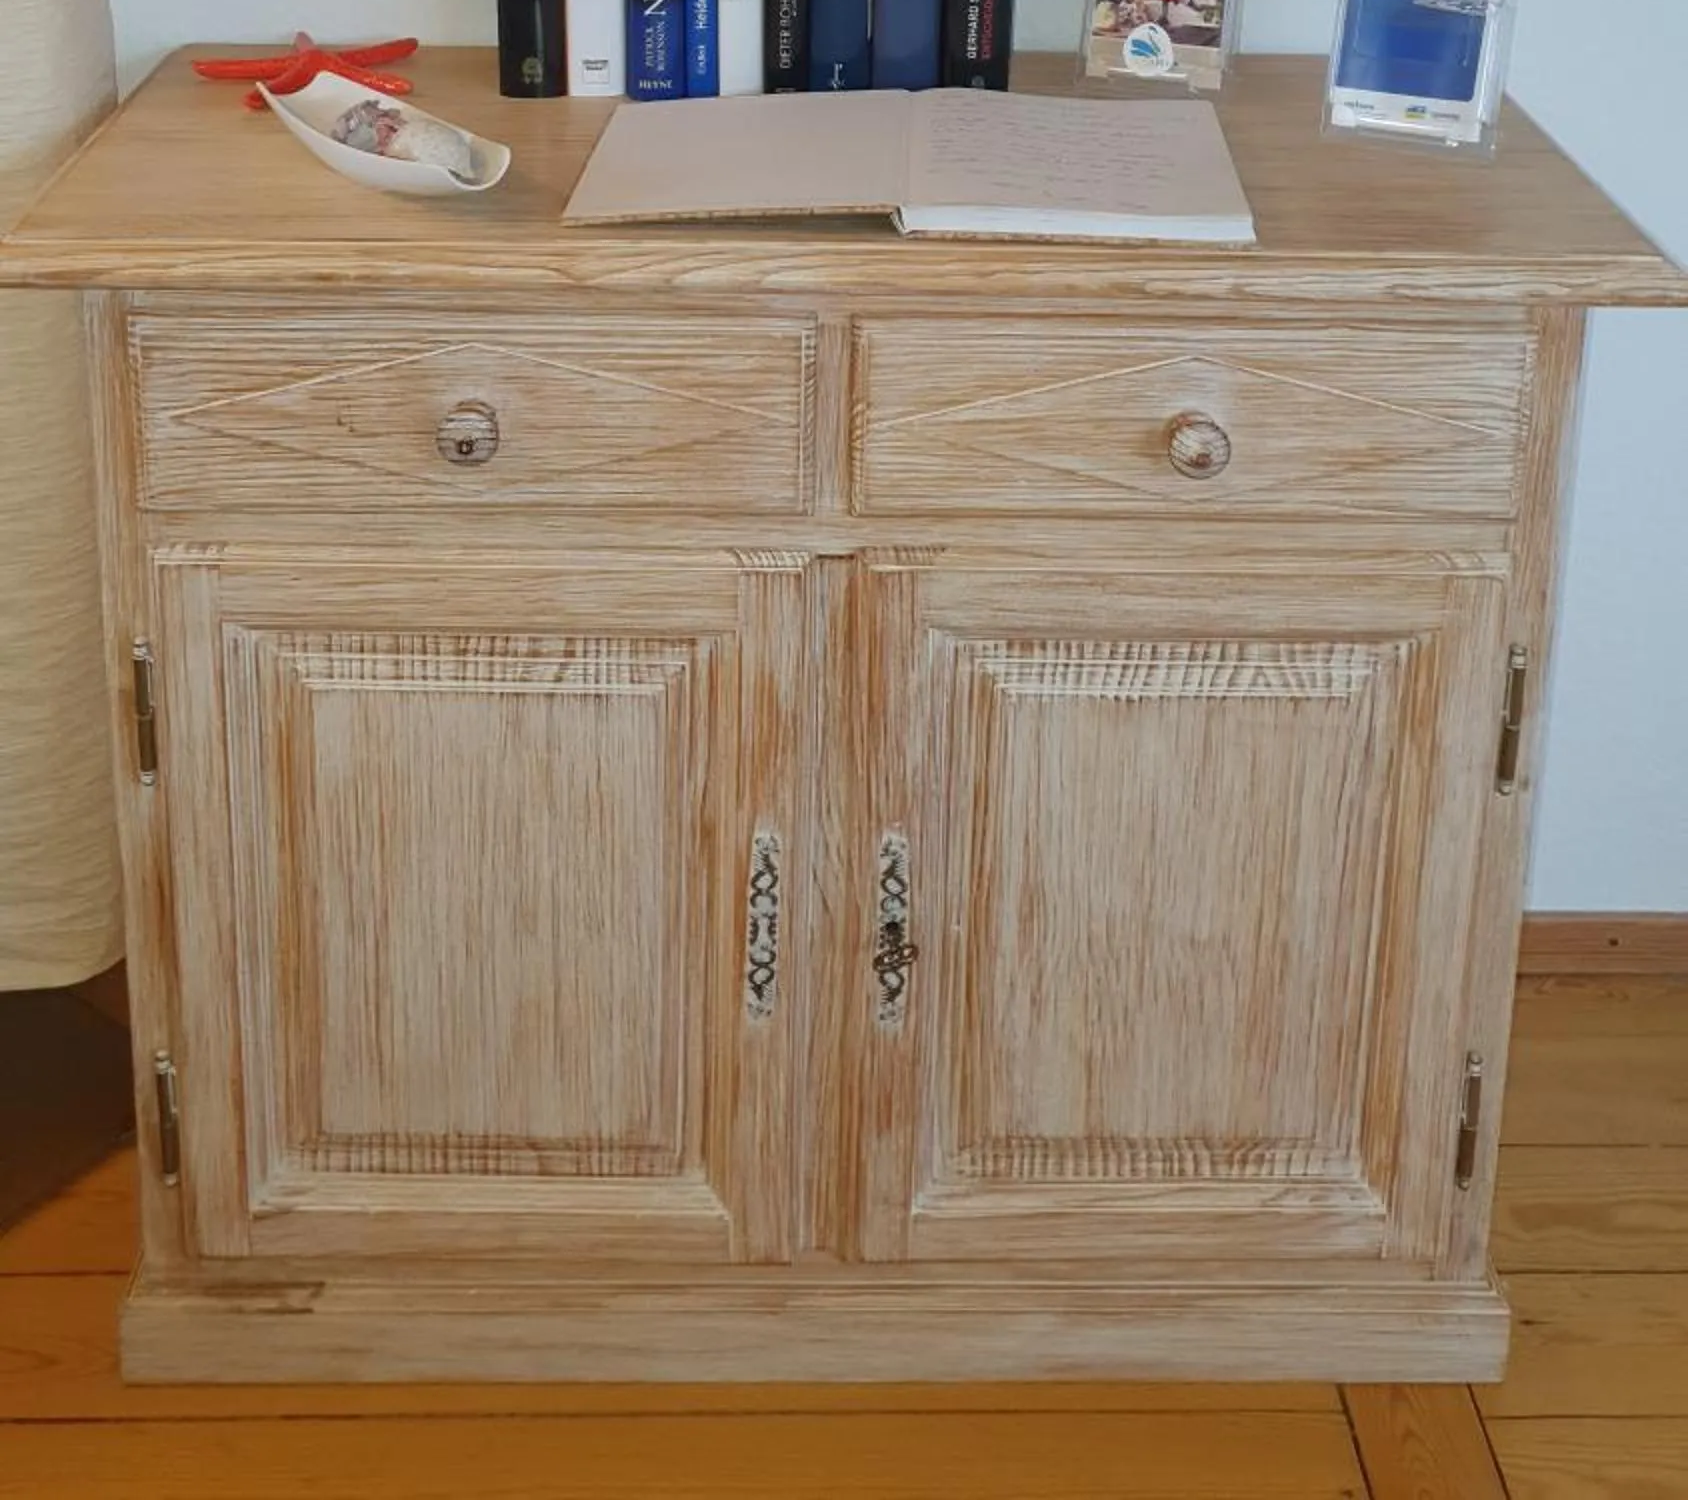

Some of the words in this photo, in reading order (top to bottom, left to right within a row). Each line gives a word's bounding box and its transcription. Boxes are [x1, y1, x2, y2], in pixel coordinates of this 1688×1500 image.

[779, 28, 793, 69] DIETER
[965, 5, 980, 60] GERHARD
[638, 78, 674, 90] HEYNE
